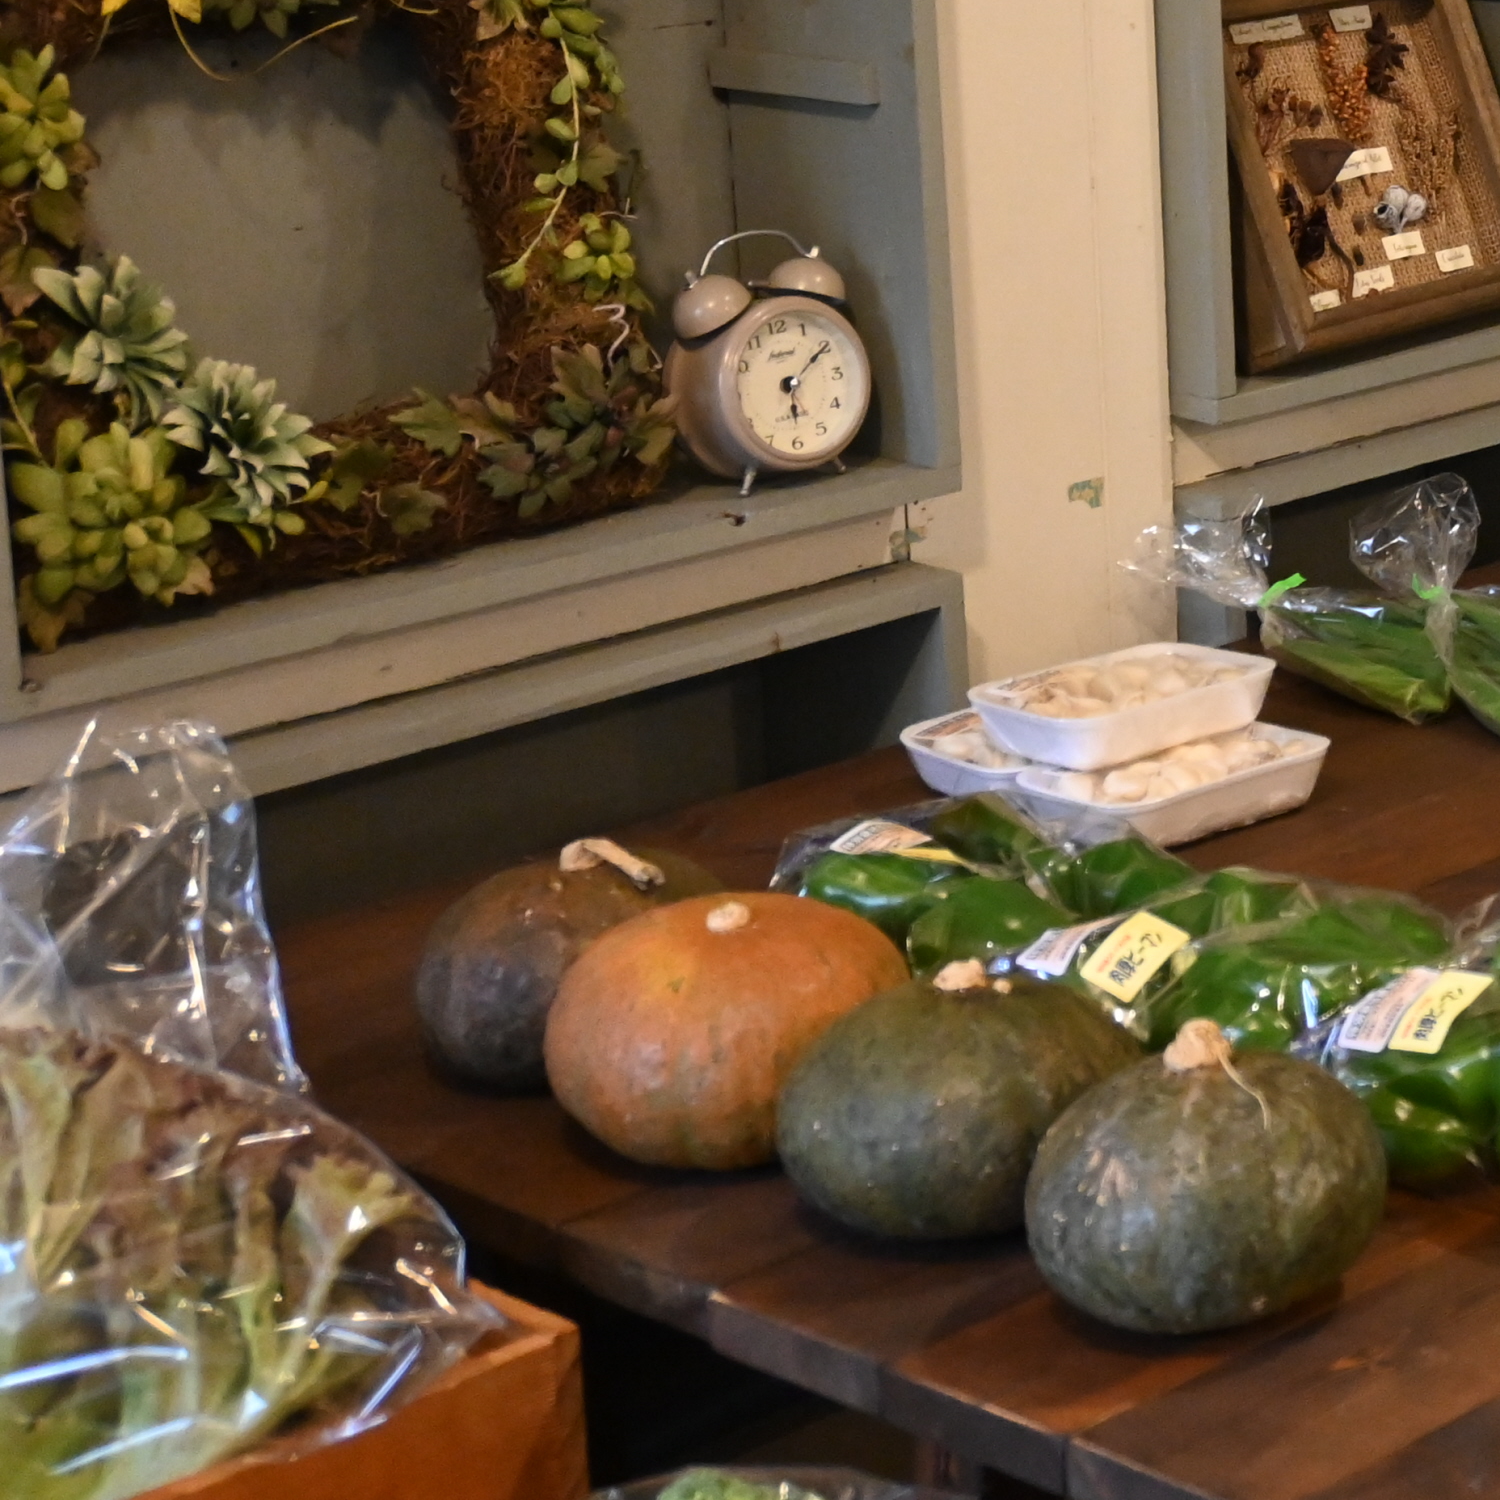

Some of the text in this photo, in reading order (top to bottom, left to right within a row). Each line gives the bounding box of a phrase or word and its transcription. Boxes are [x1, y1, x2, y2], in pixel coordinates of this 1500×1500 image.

[767, 320, 787, 335] 12
[798, 323, 806, 336] 1
[747, 335, 761, 350] 11
[818, 340, 831, 354] 2
[738, 360, 750, 373] 0
[831, 366, 844, 381] 3
[829, 396, 841, 409] 4
[815, 422, 827, 436] 5
[791, 436, 804, 450] 6
